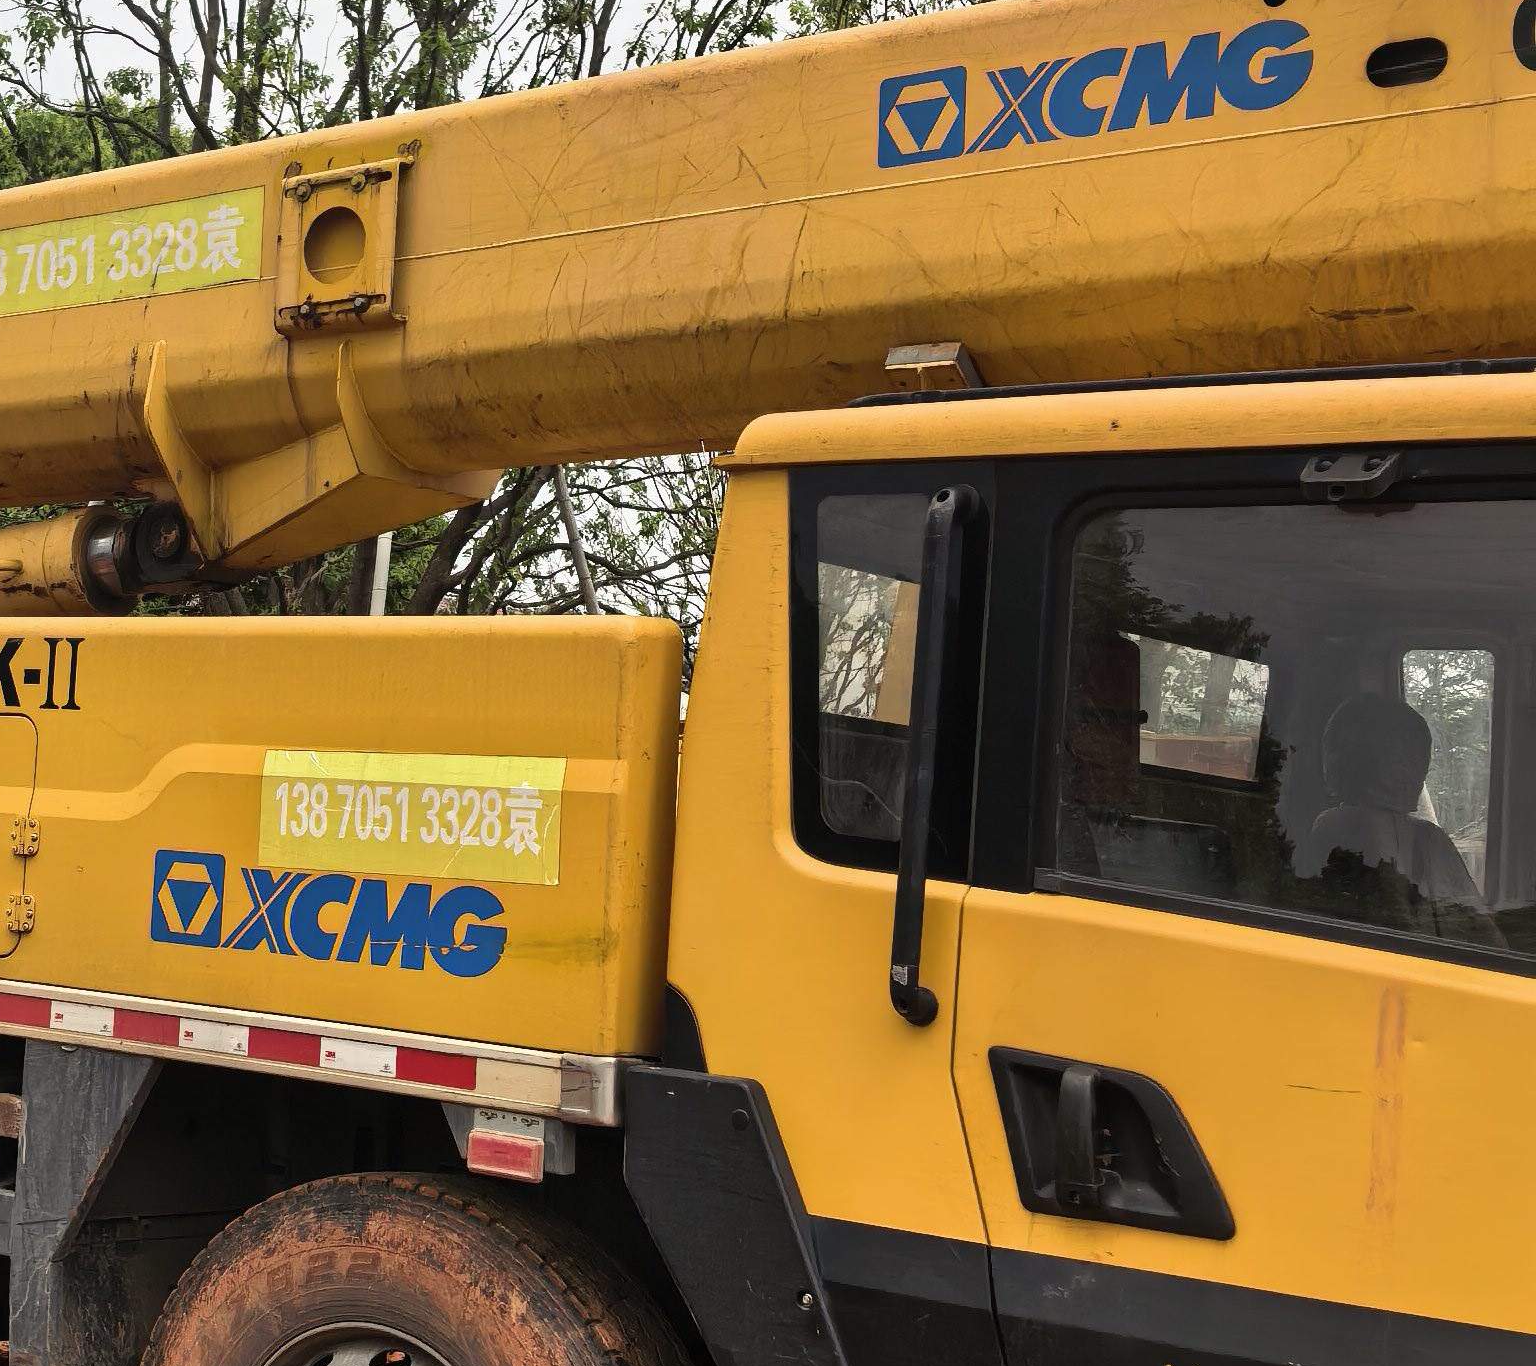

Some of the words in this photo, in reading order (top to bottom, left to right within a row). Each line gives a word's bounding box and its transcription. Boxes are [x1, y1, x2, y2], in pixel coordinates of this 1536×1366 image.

[965, 20, 1314, 155] XCMG
[15, 234, 95, 295] 7051
[106, 203, 245, 282] 3328袁
[274, 781, 329, 839] 138
[335, 784, 410, 843] 7051
[418, 779, 544, 857] 3328袁
[219, 867, 509, 978] XCMG
